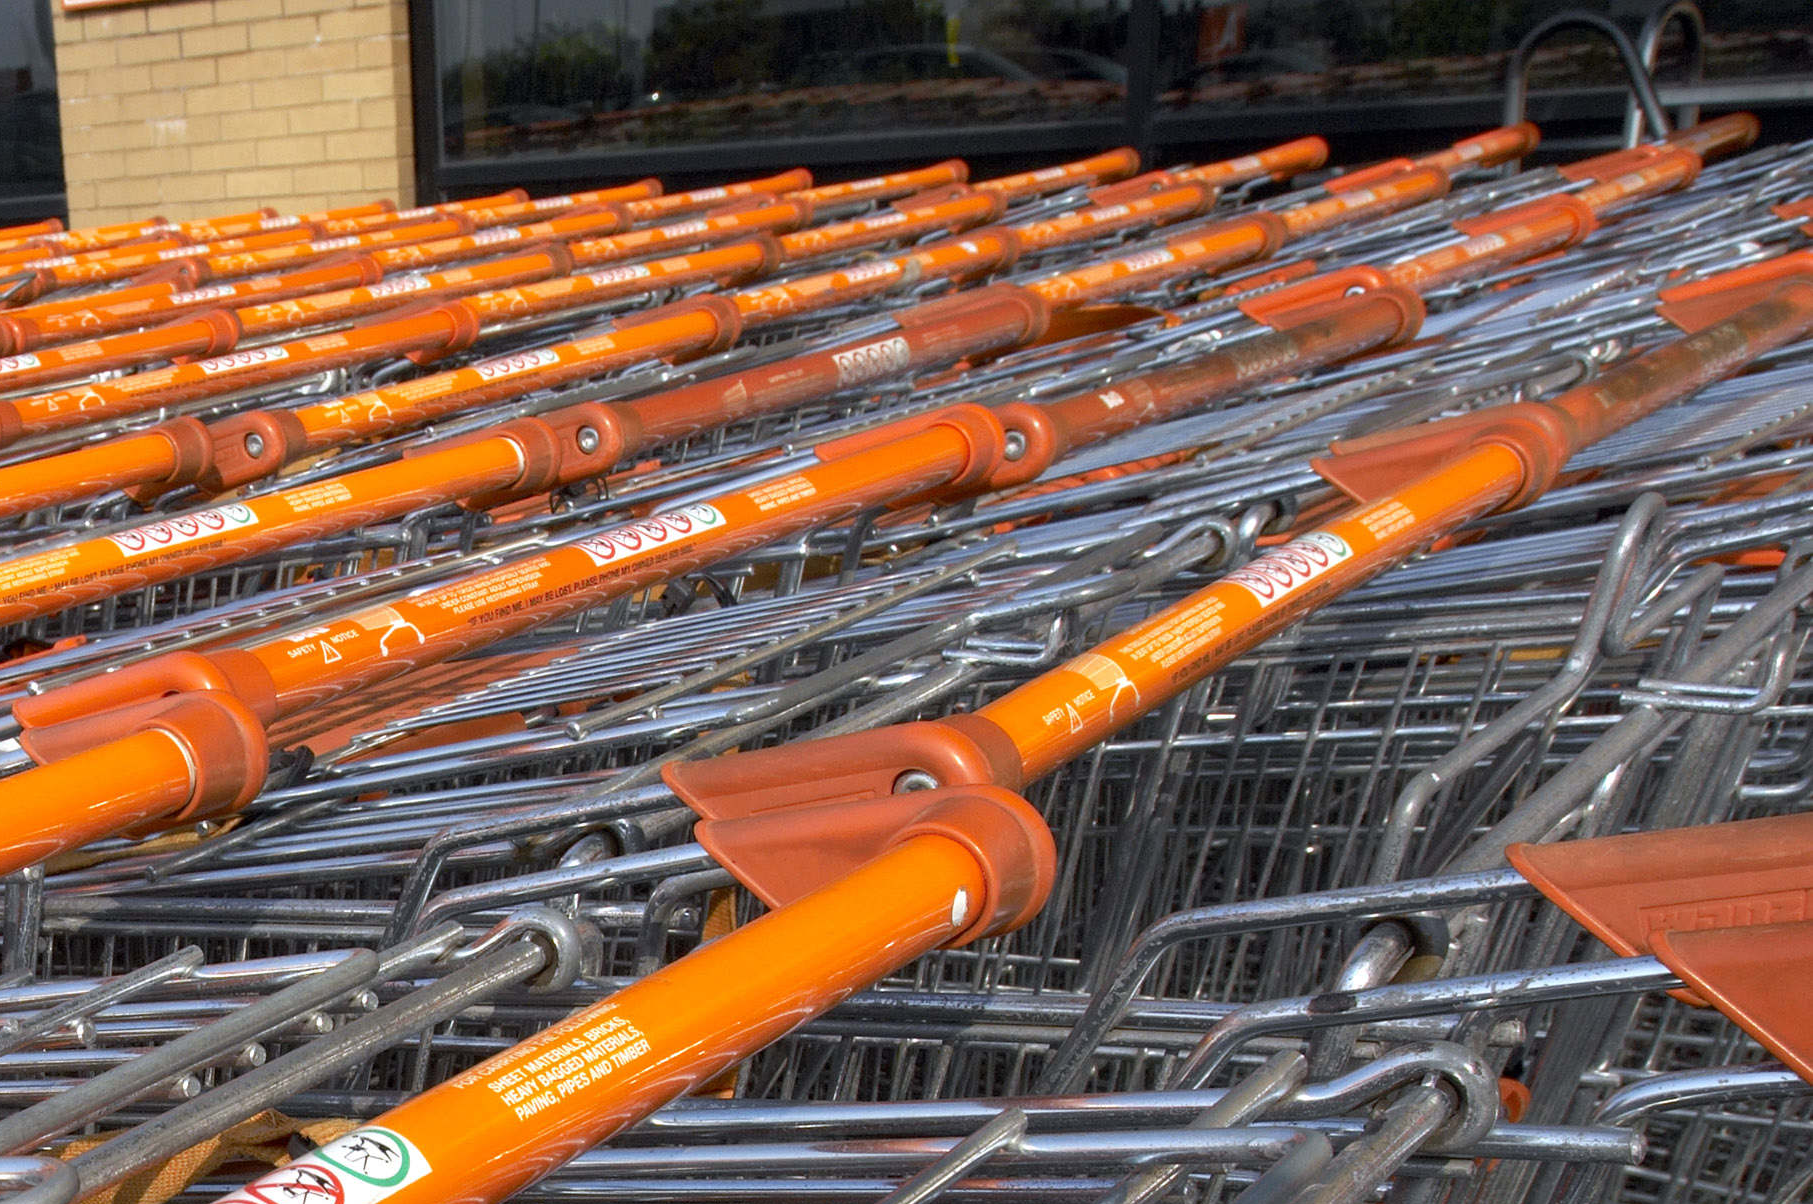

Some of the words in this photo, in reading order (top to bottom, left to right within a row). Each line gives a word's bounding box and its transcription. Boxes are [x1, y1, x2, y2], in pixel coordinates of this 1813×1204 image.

[287, 643, 316, 658] SAFETY
[330, 629, 358, 643] NOTICE
[1042, 707, 1065, 725] SAFETY
[1072, 689, 1095, 706] NOTICE
[487, 1068, 526, 1092] SHEET
[524, 1035, 589, 1072] MATERIALS,
[585, 1016, 630, 1041] BRICKS,
[501, 1079, 539, 1106] HEAVY
[537, 1056, 584, 1086] BAGGED
[581, 1026, 643, 1062] MATERIALS,
[515, 1090, 560, 1120] PAVING,
[557, 1072, 590, 1097] PIPES
[589, 1059, 612, 1080] AND
[610, 1039, 650, 1067] TIMBER
